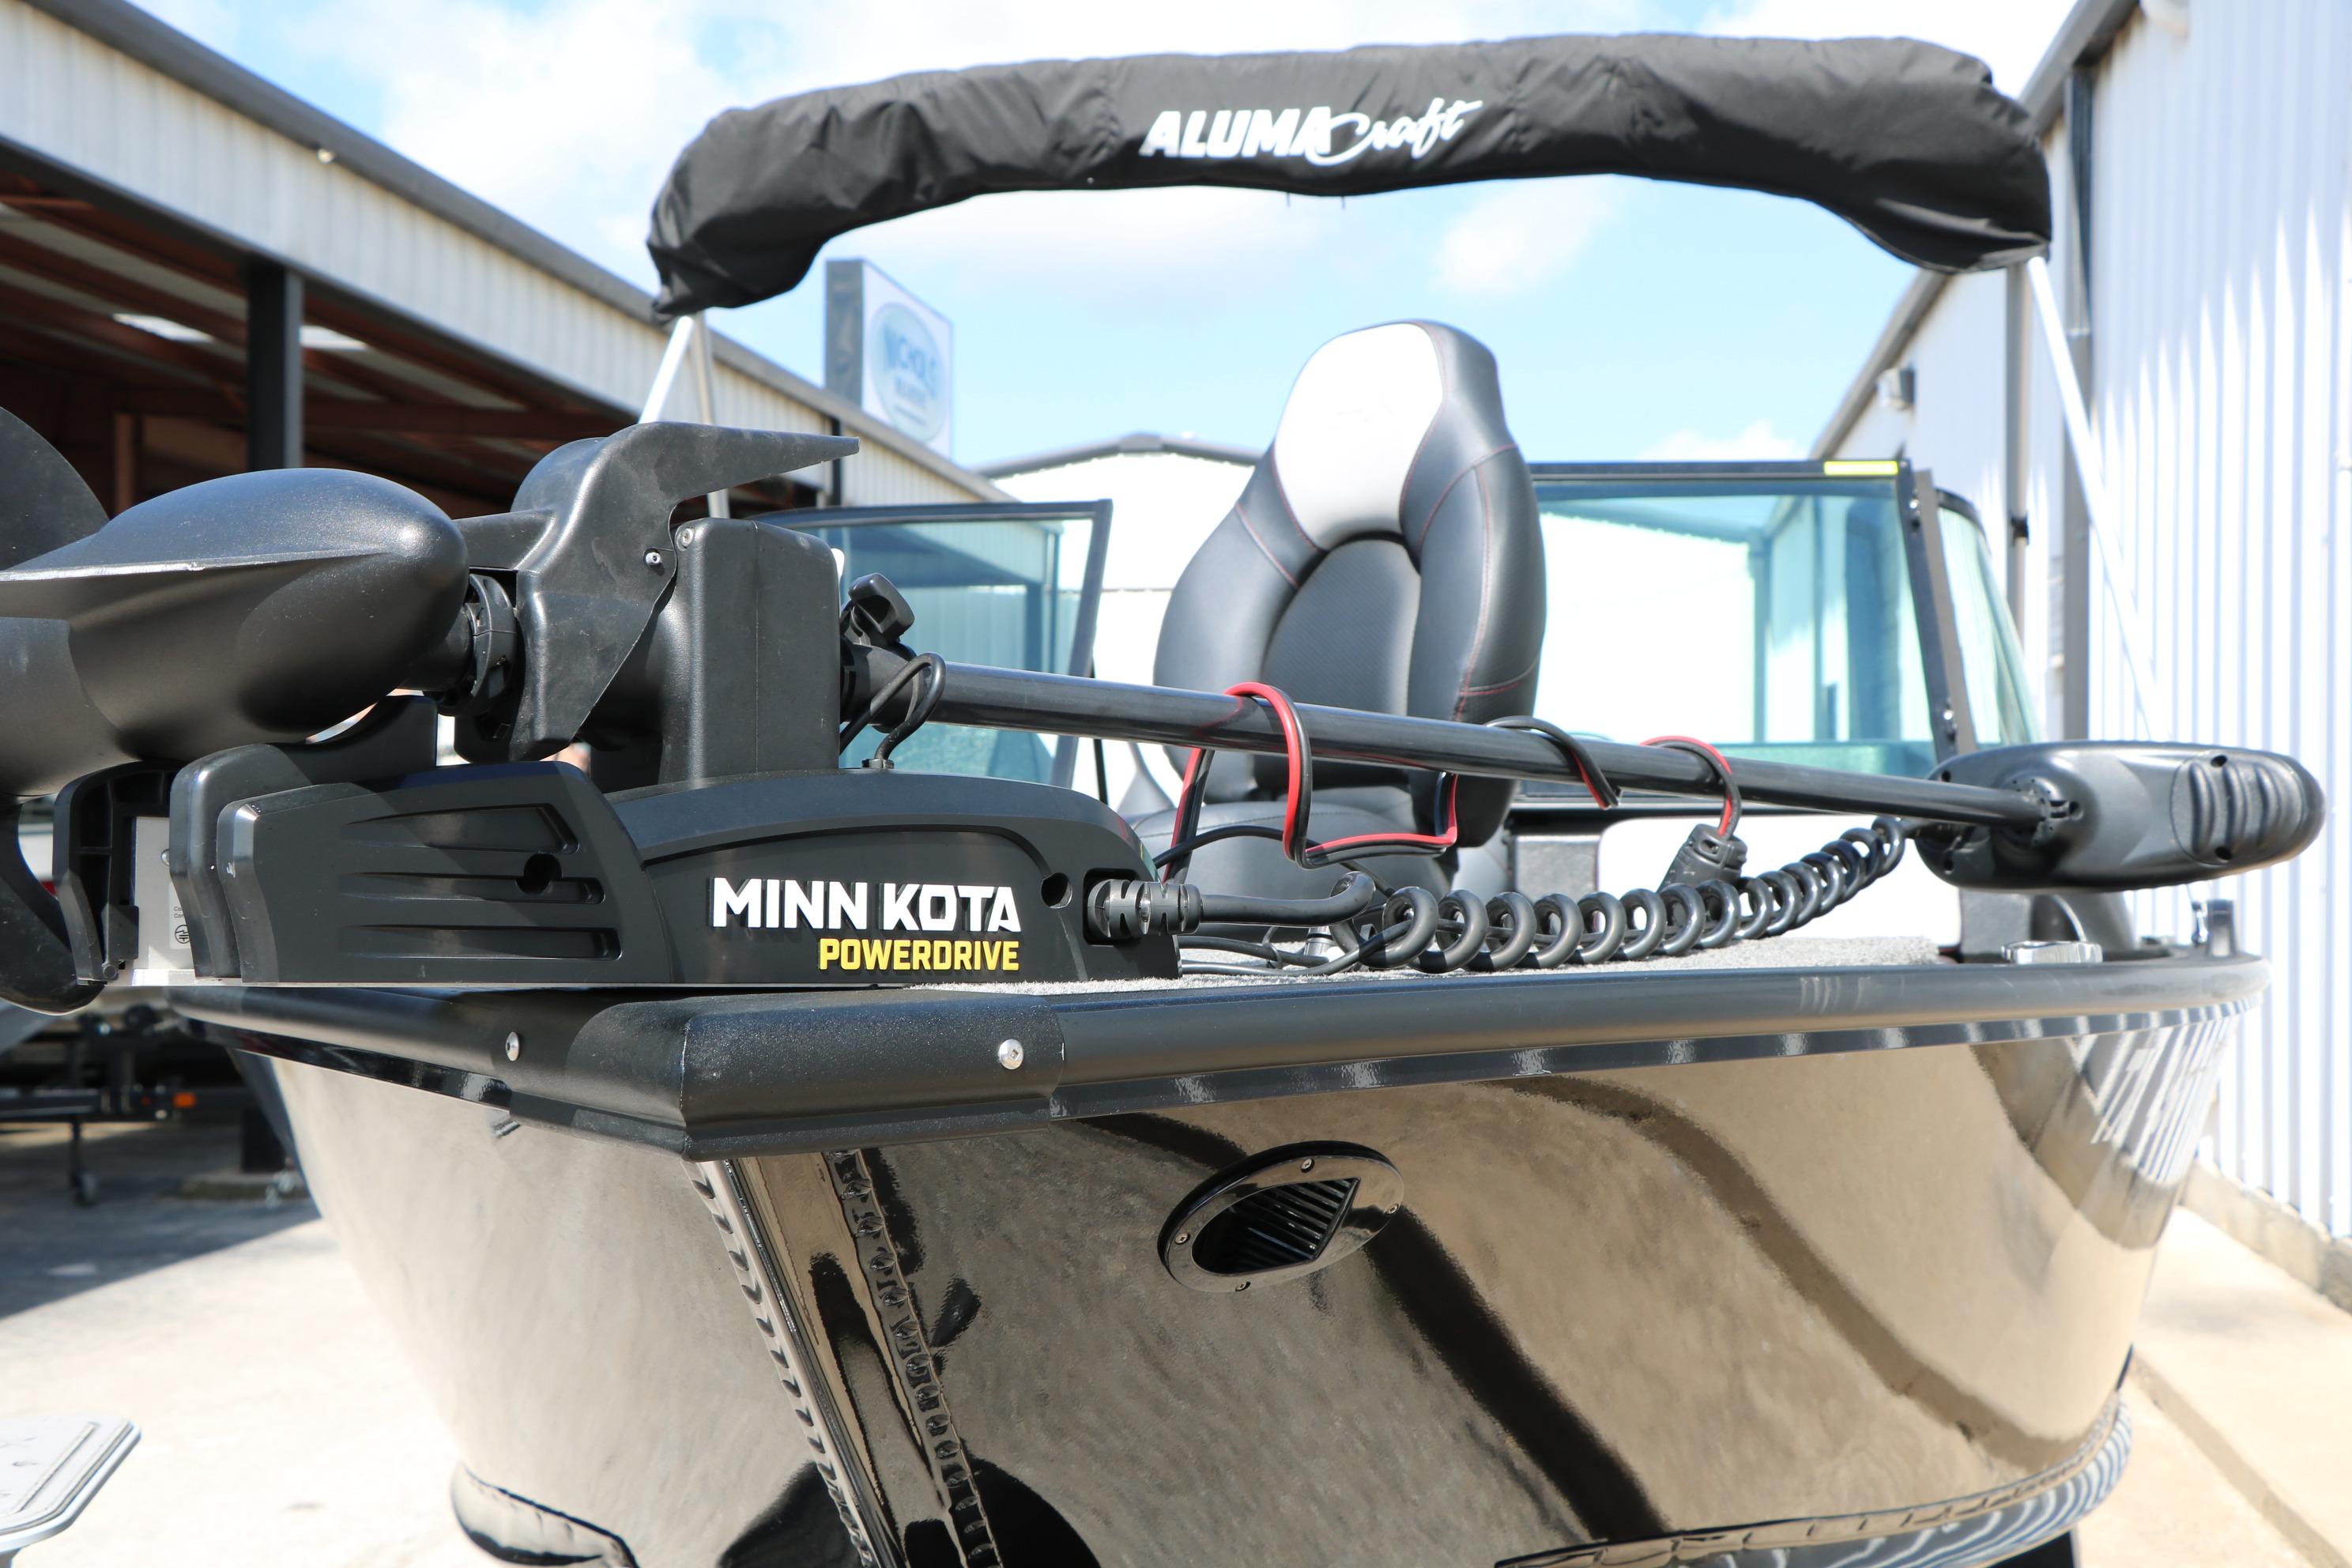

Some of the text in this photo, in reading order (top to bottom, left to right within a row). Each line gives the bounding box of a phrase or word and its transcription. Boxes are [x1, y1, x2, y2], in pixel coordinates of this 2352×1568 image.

[711, 876, 1023, 933] MINN KOTA
[819, 937, 1020, 971] POWERDRIVE
